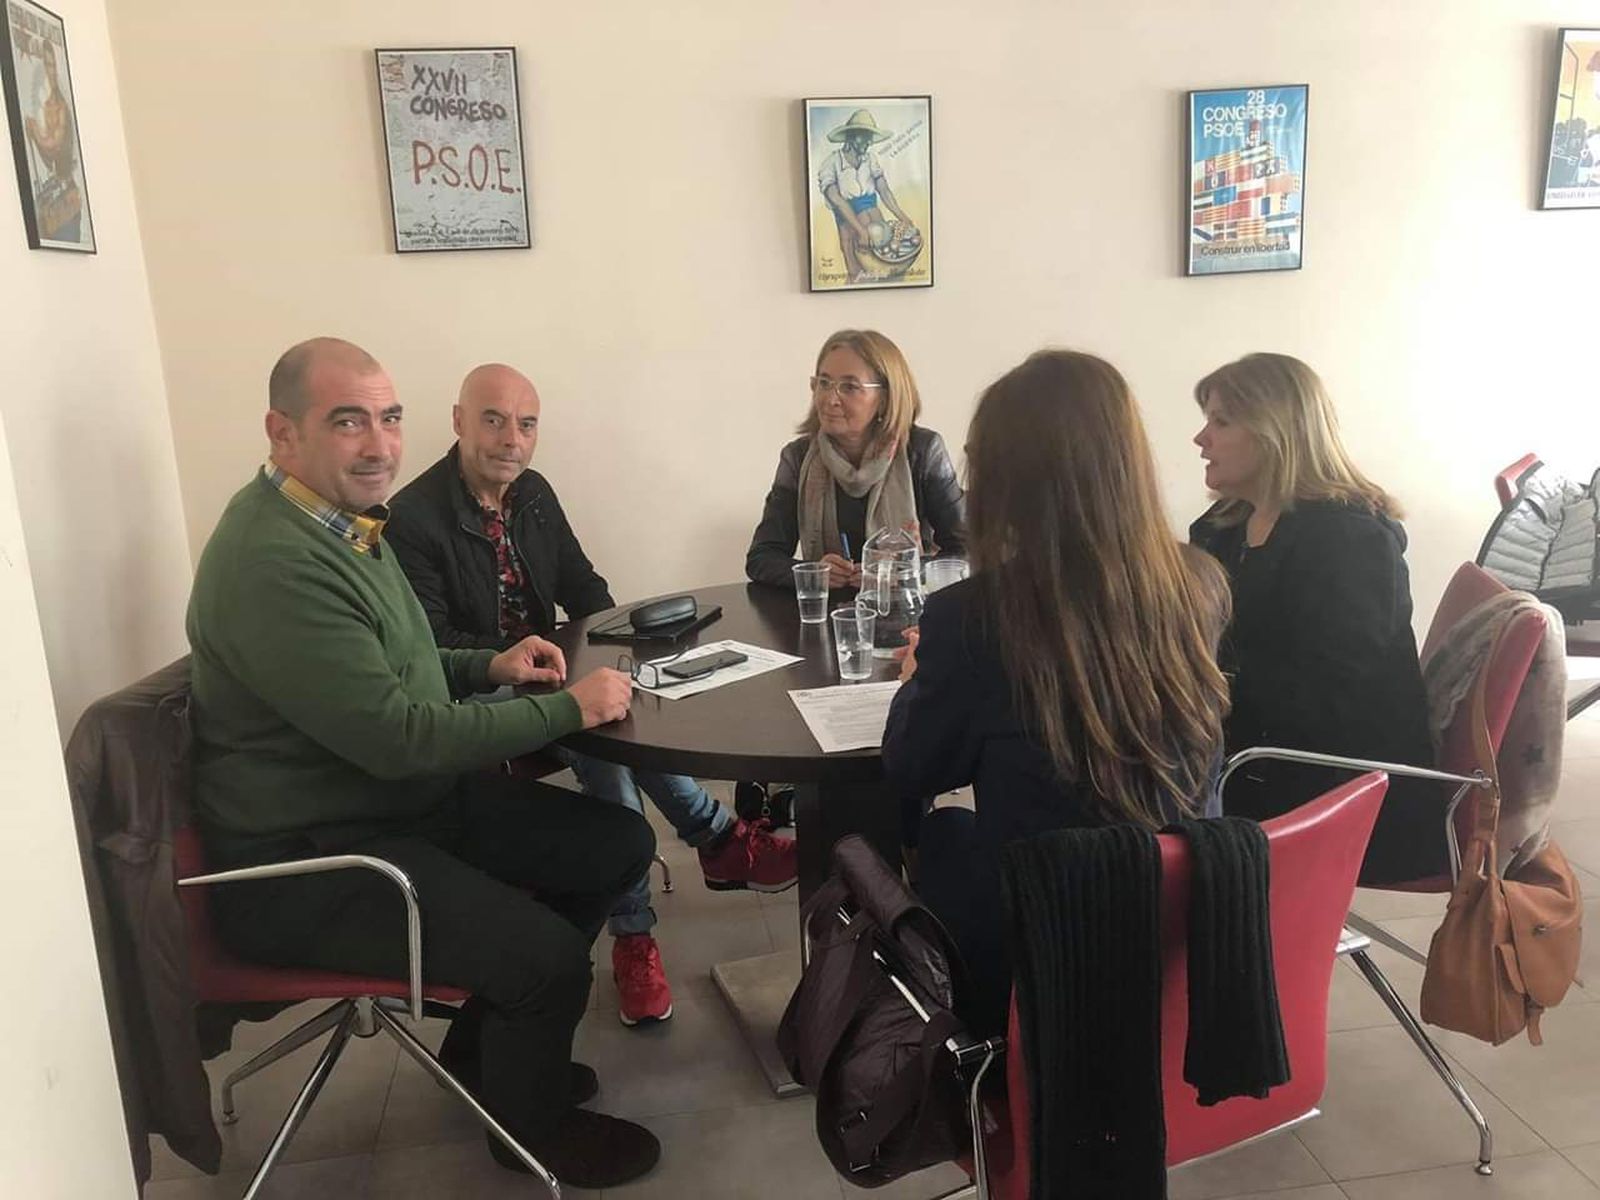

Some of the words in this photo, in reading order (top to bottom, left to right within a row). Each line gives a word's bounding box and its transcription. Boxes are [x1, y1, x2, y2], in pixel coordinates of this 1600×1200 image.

[411, 64, 467, 96] XXVII
[1247, 90, 1265, 104] 28
[410, 96, 507, 121] CONGRESO
[1203, 104, 1288, 122] CONGRESO
[1203, 122, 1245, 139] PSOE
[412, 140, 522, 194] P.S.O.E.
